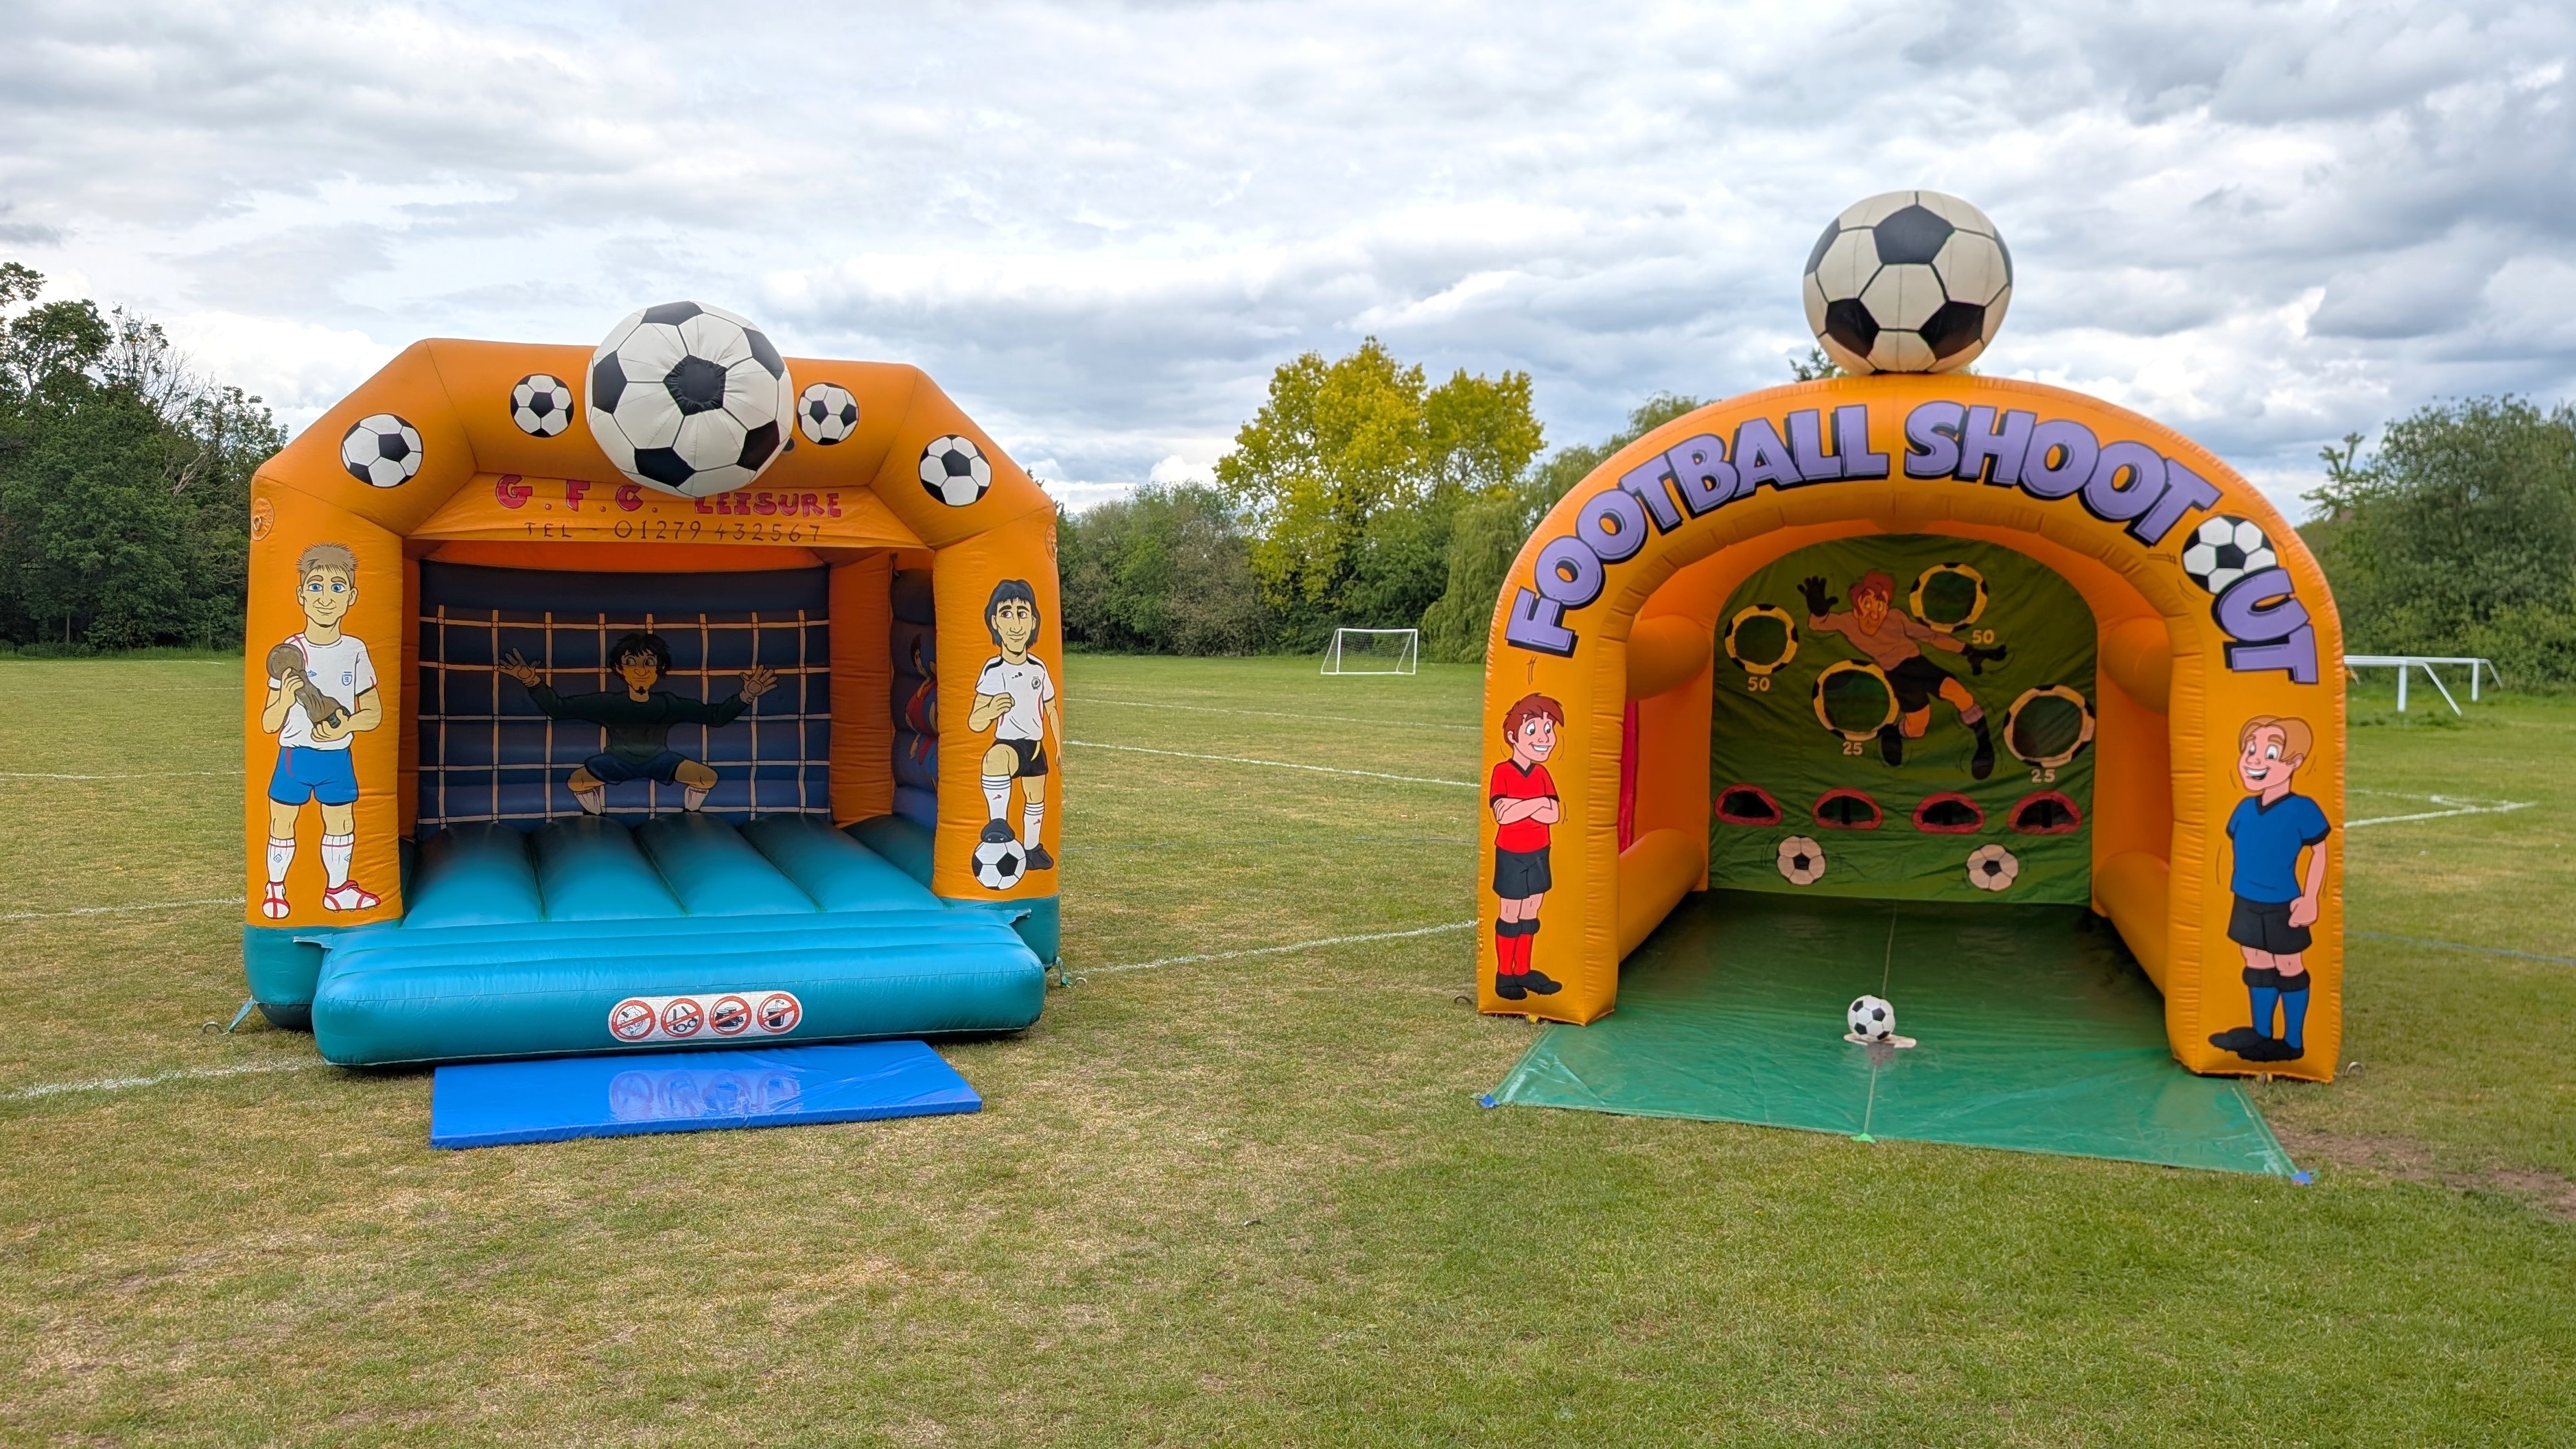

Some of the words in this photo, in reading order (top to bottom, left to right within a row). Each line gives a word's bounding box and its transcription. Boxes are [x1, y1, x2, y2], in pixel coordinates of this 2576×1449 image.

[694, 492, 842, 519] LEISURE
[524, 521, 573, 539] TEL
[614, 519, 701, 541] 01279
[714, 522, 820, 543] 432567
[1505, 403, 1890, 659] FOOTBALL
[1904, 400, 2224, 548] SHOOT
[1972, 628, 1995, 645] 50
[1748, 676, 1770, 692] 50
[1842, 741, 1863, 756] 25
[2031, 768, 2056, 784] 25
